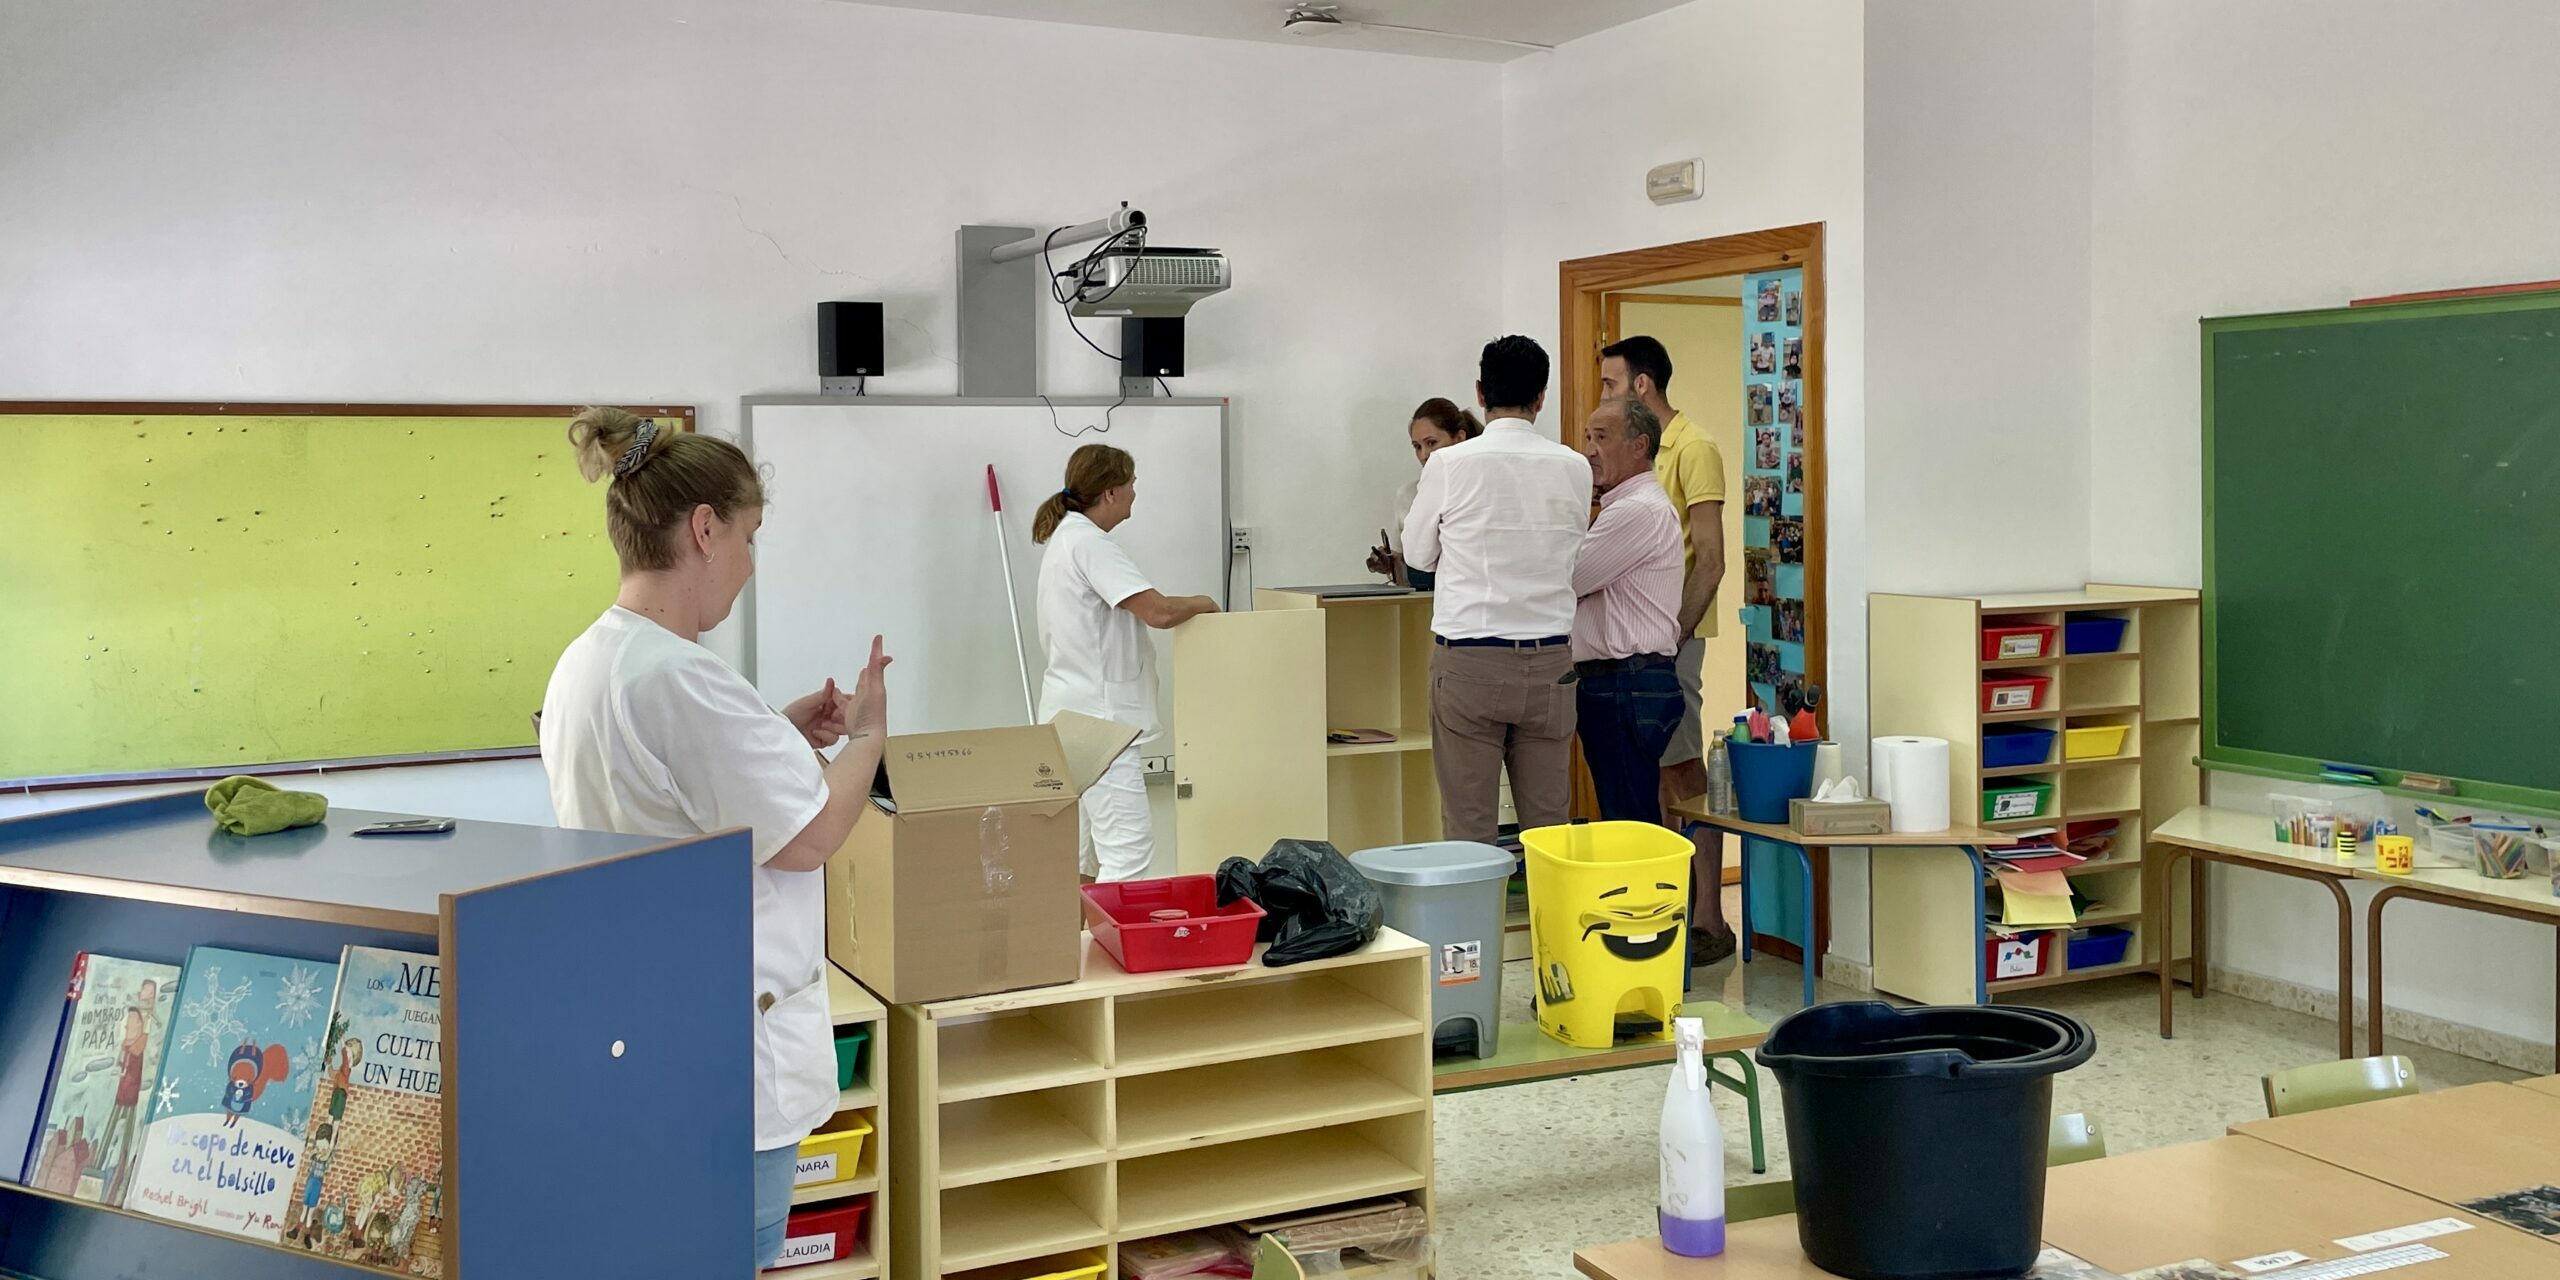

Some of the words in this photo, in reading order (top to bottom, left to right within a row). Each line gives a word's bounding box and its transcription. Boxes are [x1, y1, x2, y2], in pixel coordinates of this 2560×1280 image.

[367, 978, 384, 991] LOS
[82, 1006, 125, 1025] HOMBROS
[363, 1062, 392, 1085] UN
[192, 1134, 226, 1161] copo
[231, 1129, 248, 1156] de
[252, 1140, 295, 1168] nieve
[172, 1158, 193, 1174] en
[198, 1158, 212, 1181] el
[217, 1161, 275, 1195] bolsillo
